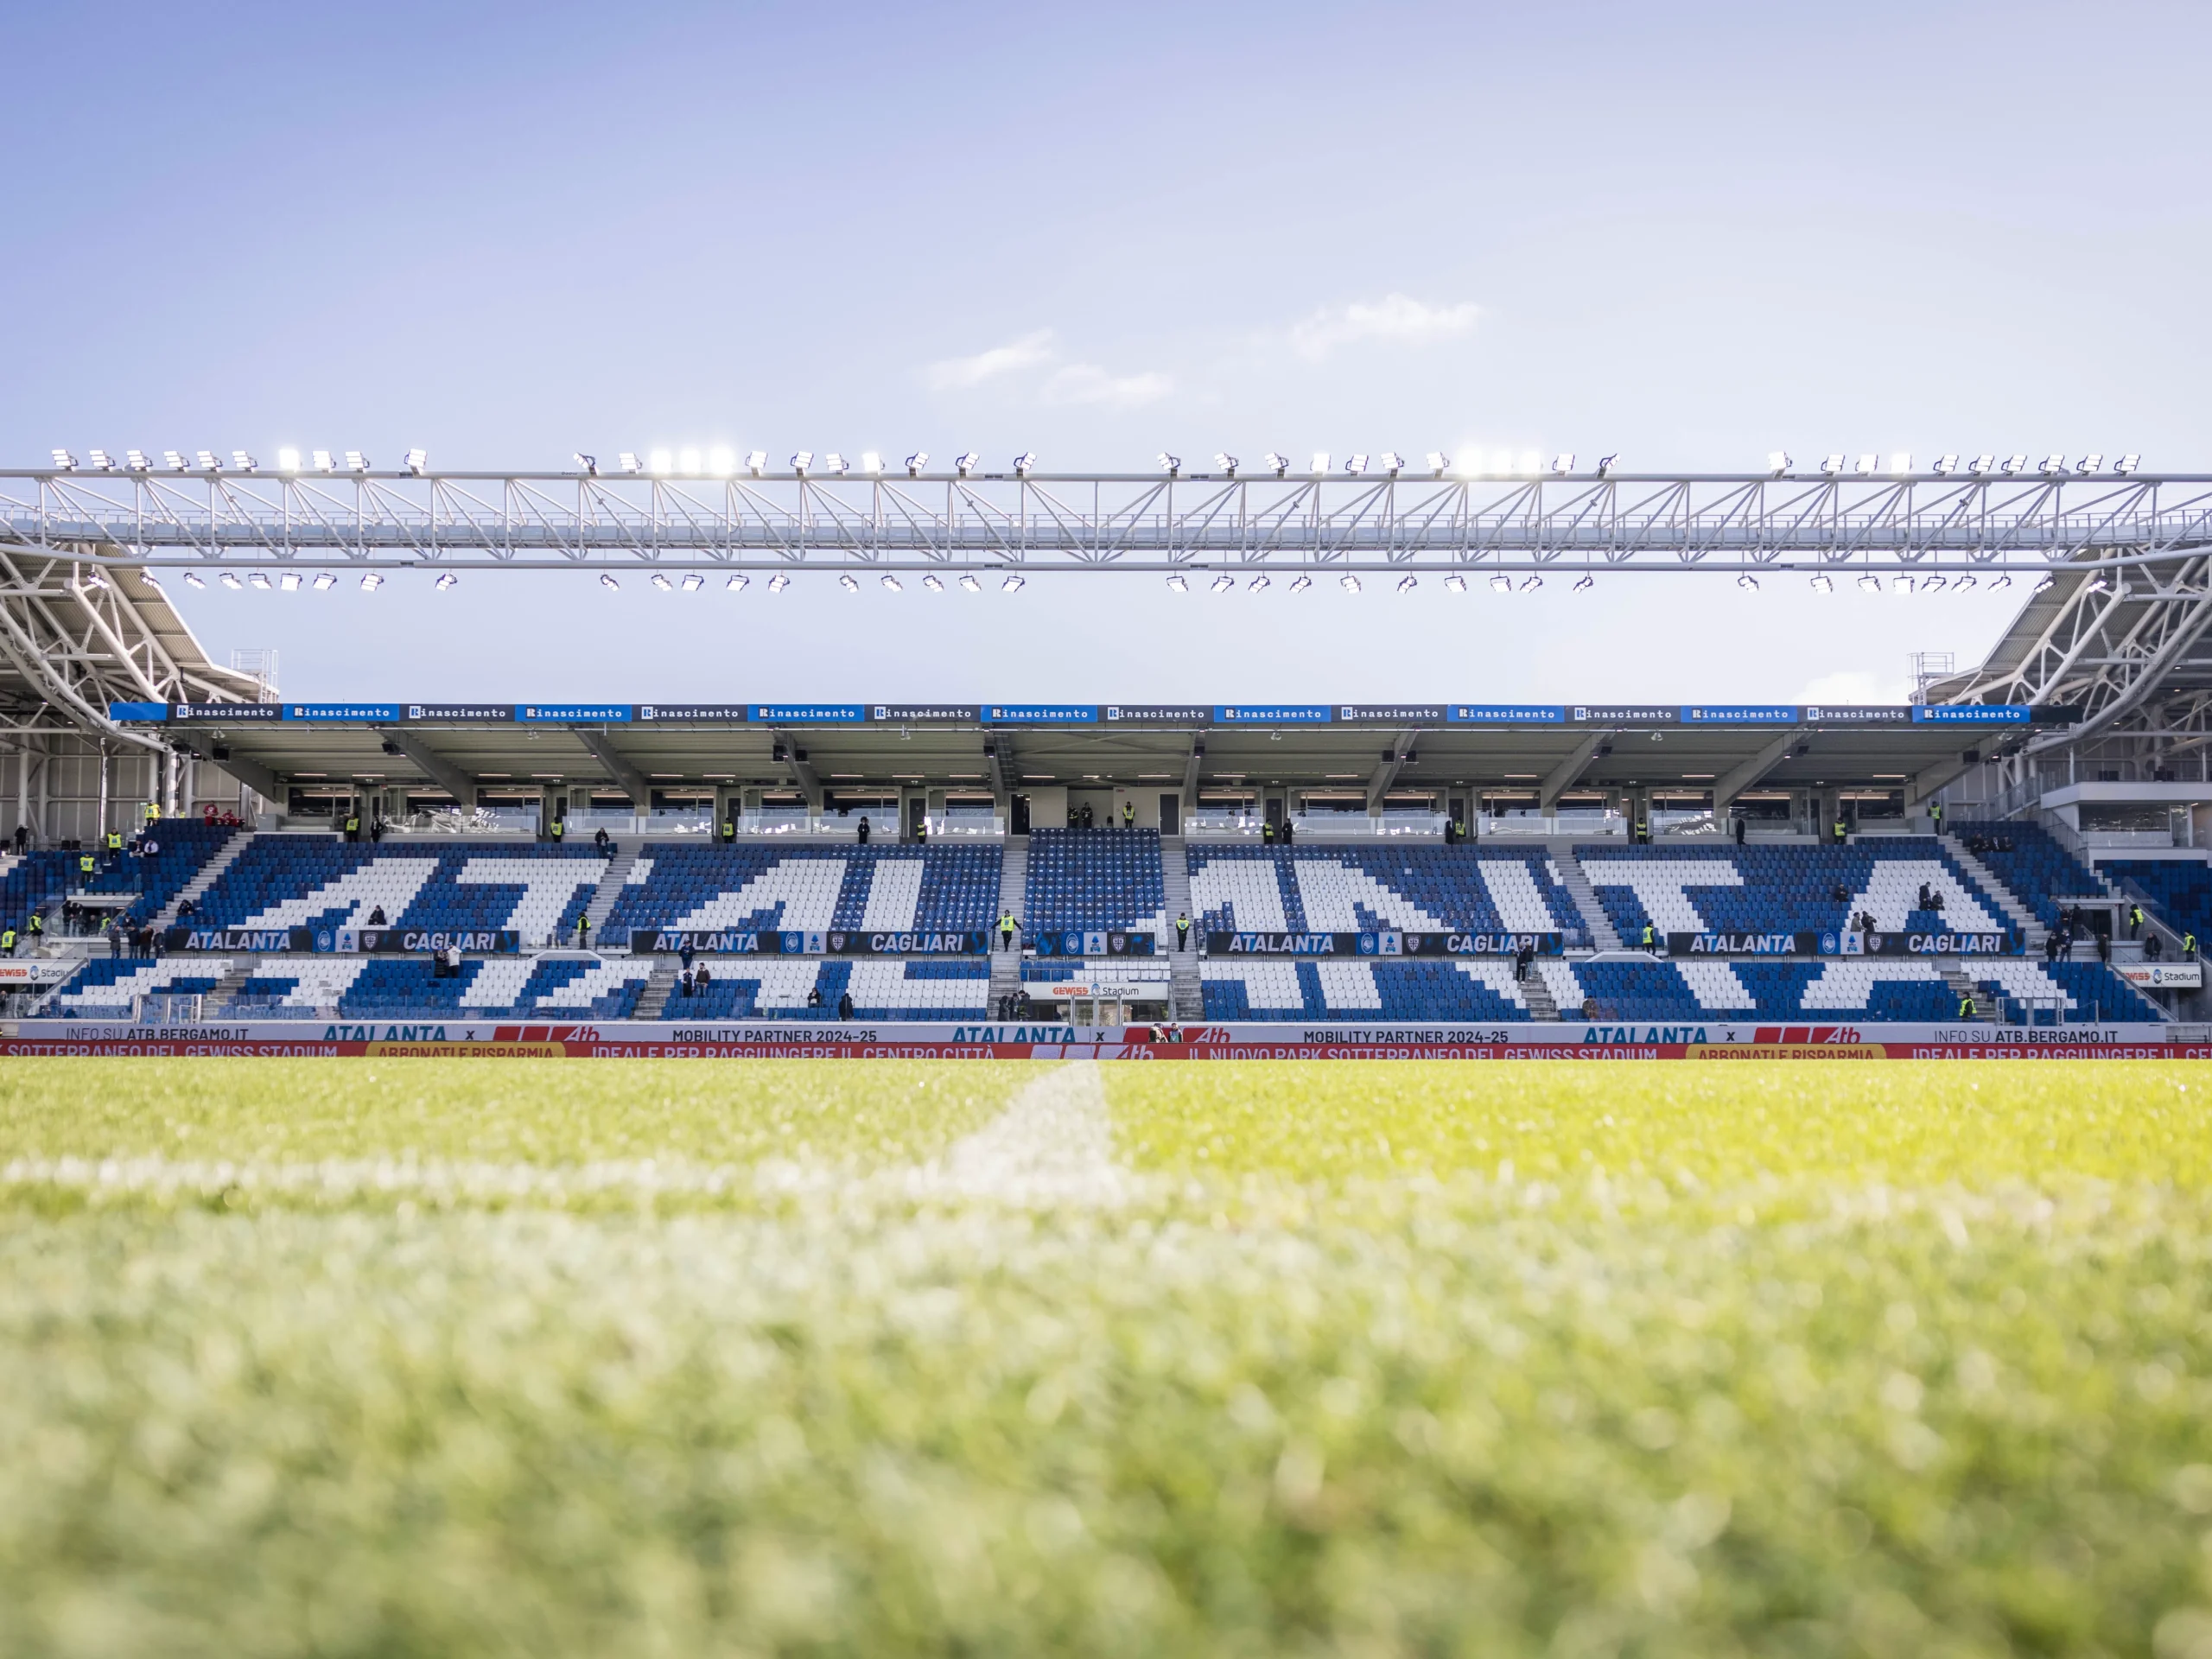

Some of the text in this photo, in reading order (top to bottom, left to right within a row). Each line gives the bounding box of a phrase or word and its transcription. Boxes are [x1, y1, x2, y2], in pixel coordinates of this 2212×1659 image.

[177, 705, 273, 719] Rinascimento
[294, 705, 390, 719] Rinascimento
[409, 705, 505, 719] Rinascimento
[526, 705, 622, 719] Rinascimento
[642, 706, 738, 720] Rinascimento
[759, 706, 855, 720] Rinascimento
[874, 706, 971, 720] Rinascimento
[992, 706, 1089, 720] Rinascimento
[1108, 706, 1205, 720] Rinascimento
[1225, 706, 1321, 720] Rinascimento
[1341, 706, 1439, 720] Rinascimento
[1459, 706, 1554, 720] Rinascimento
[1574, 707, 1671, 721] Rinascimento
[1692, 707, 1788, 721] Rinascimento
[1808, 707, 1904, 721] Rinascimento
[1924, 707, 2020, 721] Rinascimento
[185, 932, 290, 950] ATALANTA
[404, 932, 496, 950] CAGLIARI
[652, 932, 759, 951] ATALANTA
[872, 933, 963, 951] CAGLIARI
[1229, 934, 1334, 952] ATALANTA
[1446, 934, 1540, 952] CAGLIARI
[1690, 934, 1796, 952] ATALANTA
[1908, 934, 2001, 952] CAGLIARI
[2164, 972, 2200, 981] Stadium
[1103, 987, 1140, 995] Stadium
[67, 1027, 249, 1040] INFO SU ATB.BERGAMO.IT
[323, 1026, 447, 1040] ATALANTA
[673, 1031, 877, 1041] MOBILITY PARTNER 2024-25
[952, 1027, 1077, 1042] ATALANTA
[1304, 1031, 1509, 1042] MOBILITY PARTNER 2024-25
[1583, 1027, 1707, 1042] ATALANTA
[1934, 1030, 2118, 1042] INFO SU ATB.BERGAMO.IT
